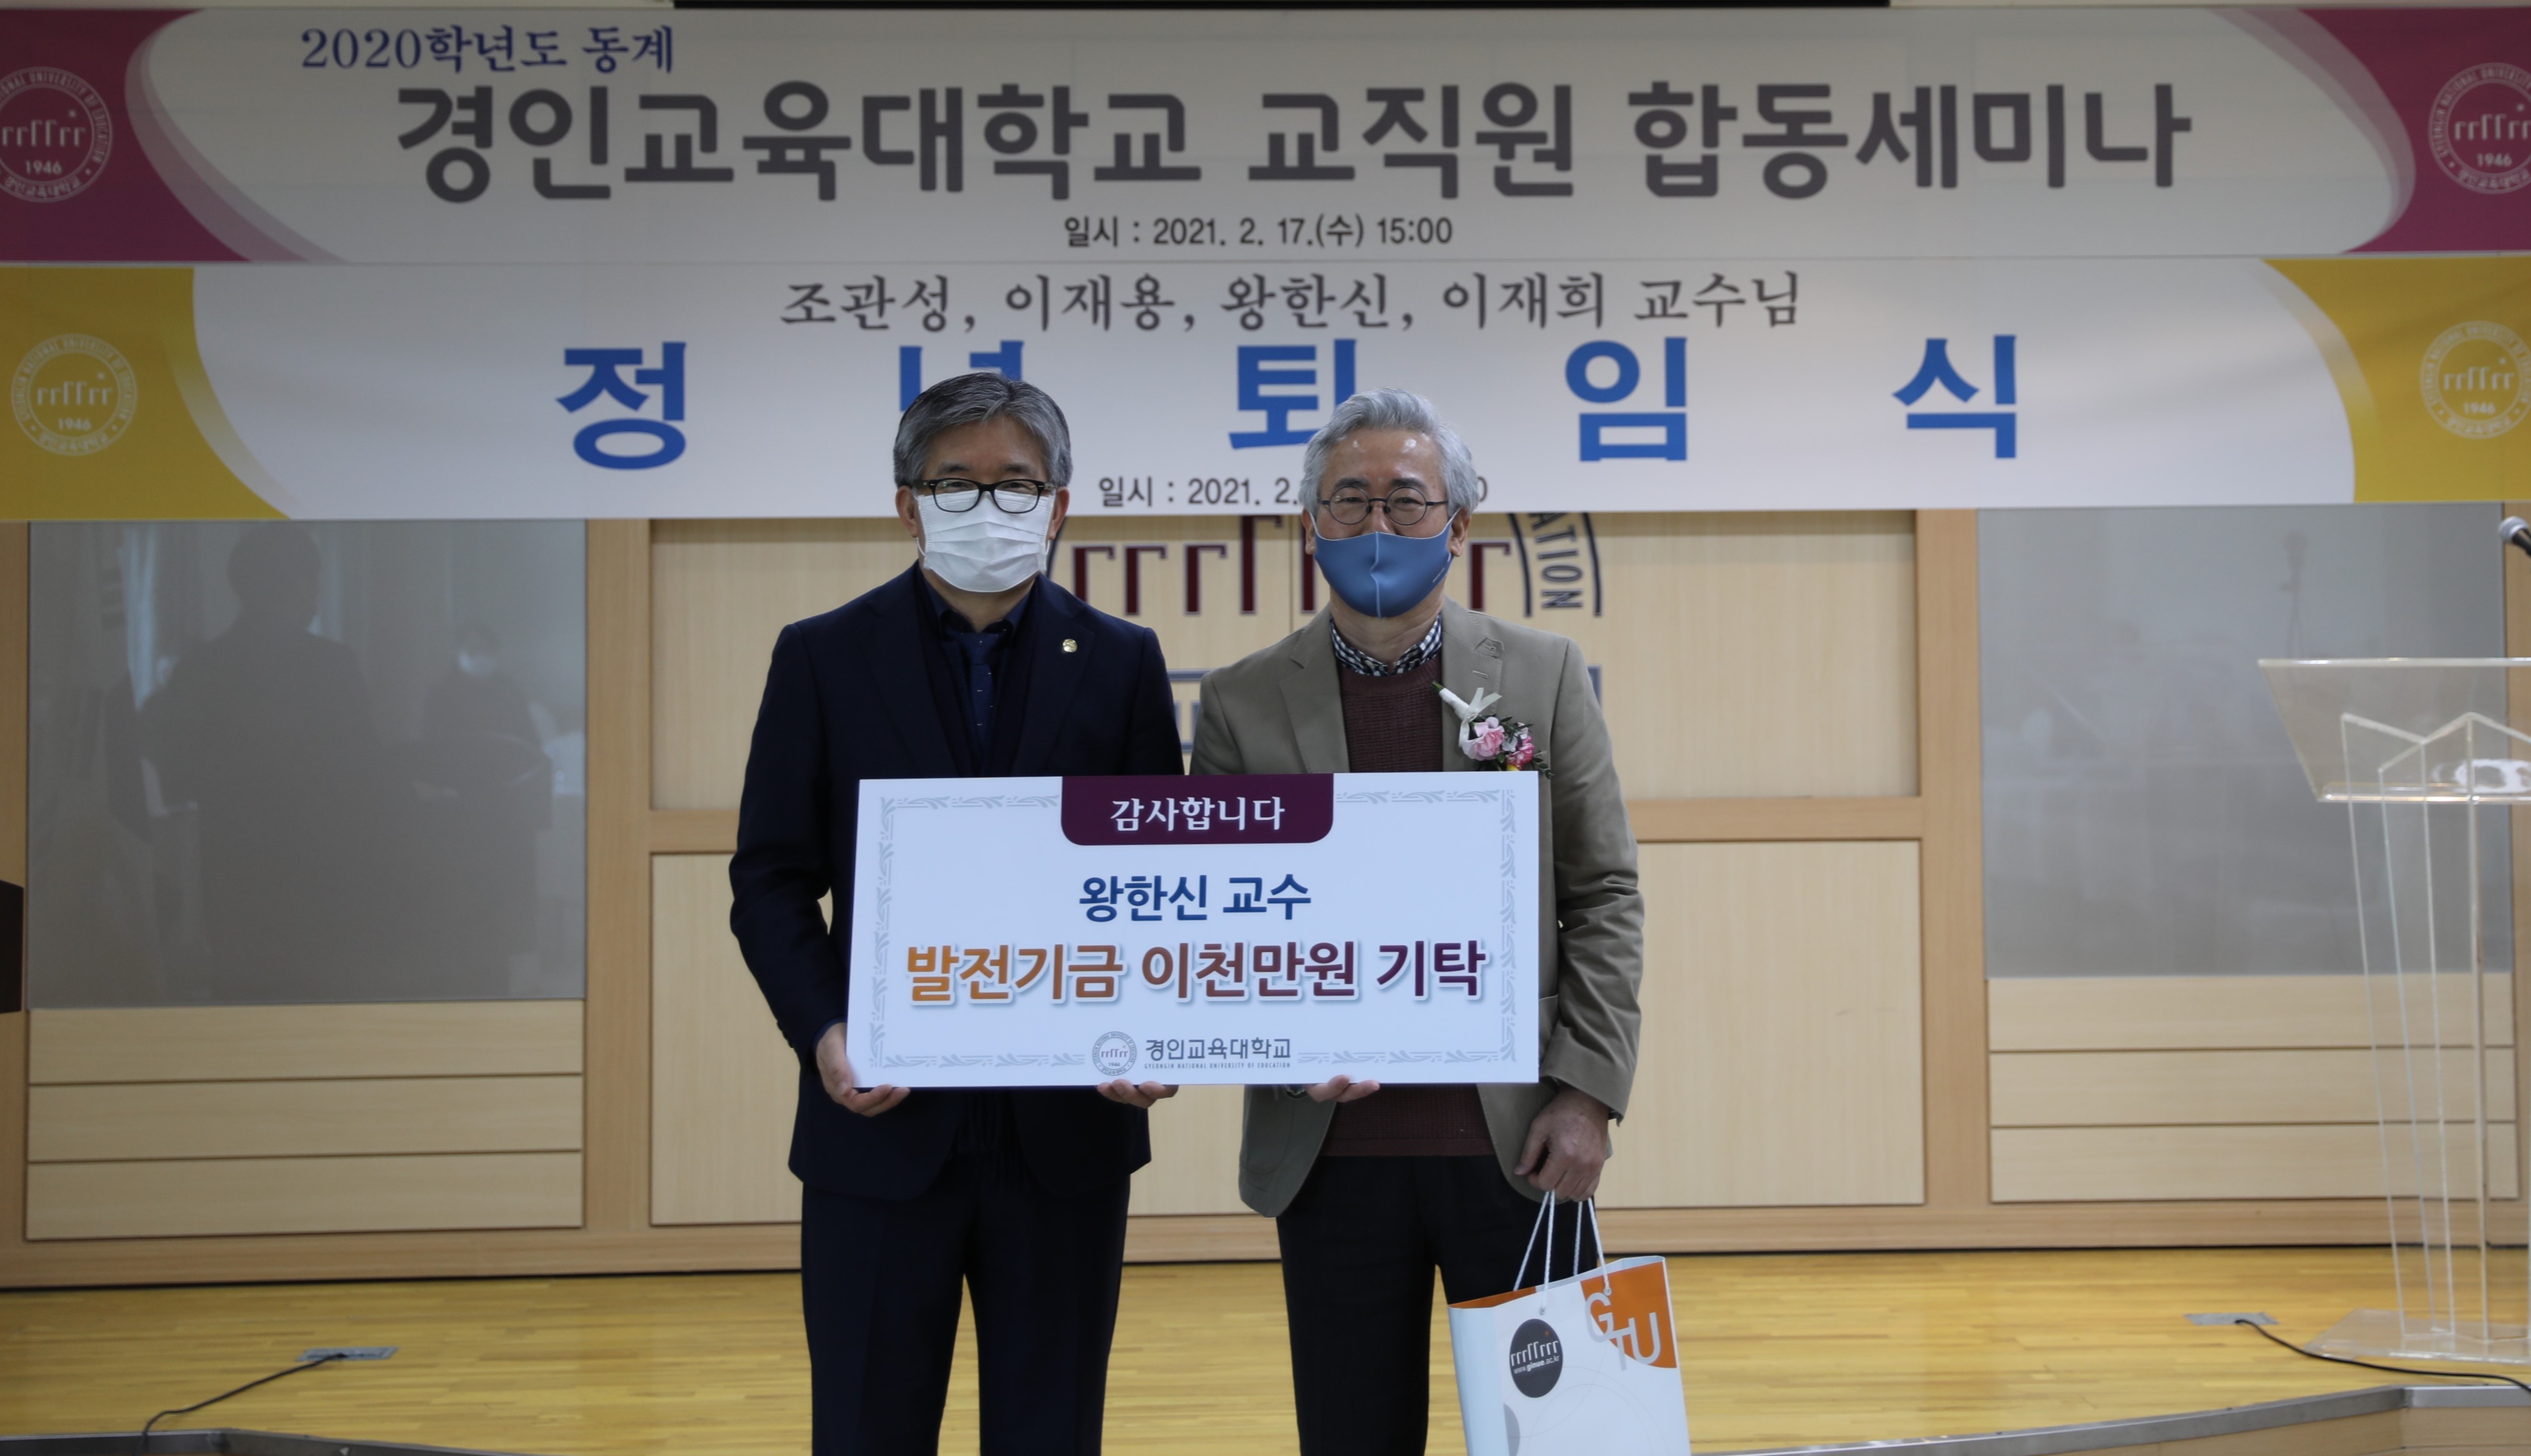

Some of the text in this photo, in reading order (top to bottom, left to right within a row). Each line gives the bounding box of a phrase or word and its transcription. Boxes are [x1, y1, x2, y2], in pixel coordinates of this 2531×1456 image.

[301, 25, 673, 74] 2020학년도 동계
[398, 80, 2191, 204] 경인교육대학교 교직원 합동세미나
[25, 159, 63, 175] 1946
[1064, 216, 1118, 248] 일시
[1154, 217, 1226, 246] 2021.
[1240, 217, 1263, 246] 2.
[1278, 215, 1364, 247] 17.(수)
[1377, 217, 1453, 244] 15:00
[781, 271, 1798, 333] 조관성, 이재용, 왕한신, 이재희 교수님
[1099, 476, 1152, 508] 일시
[1188, 477, 1261, 506] 2021.
[1110, 796, 1286, 831] 감사합니다
[1079, 874, 1311, 922] 왕한신 교수
[907, 940, 1487, 1001] 발전기금 이천만원 기탁
[1145, 1037, 1291, 1061] 경인교육대학교
